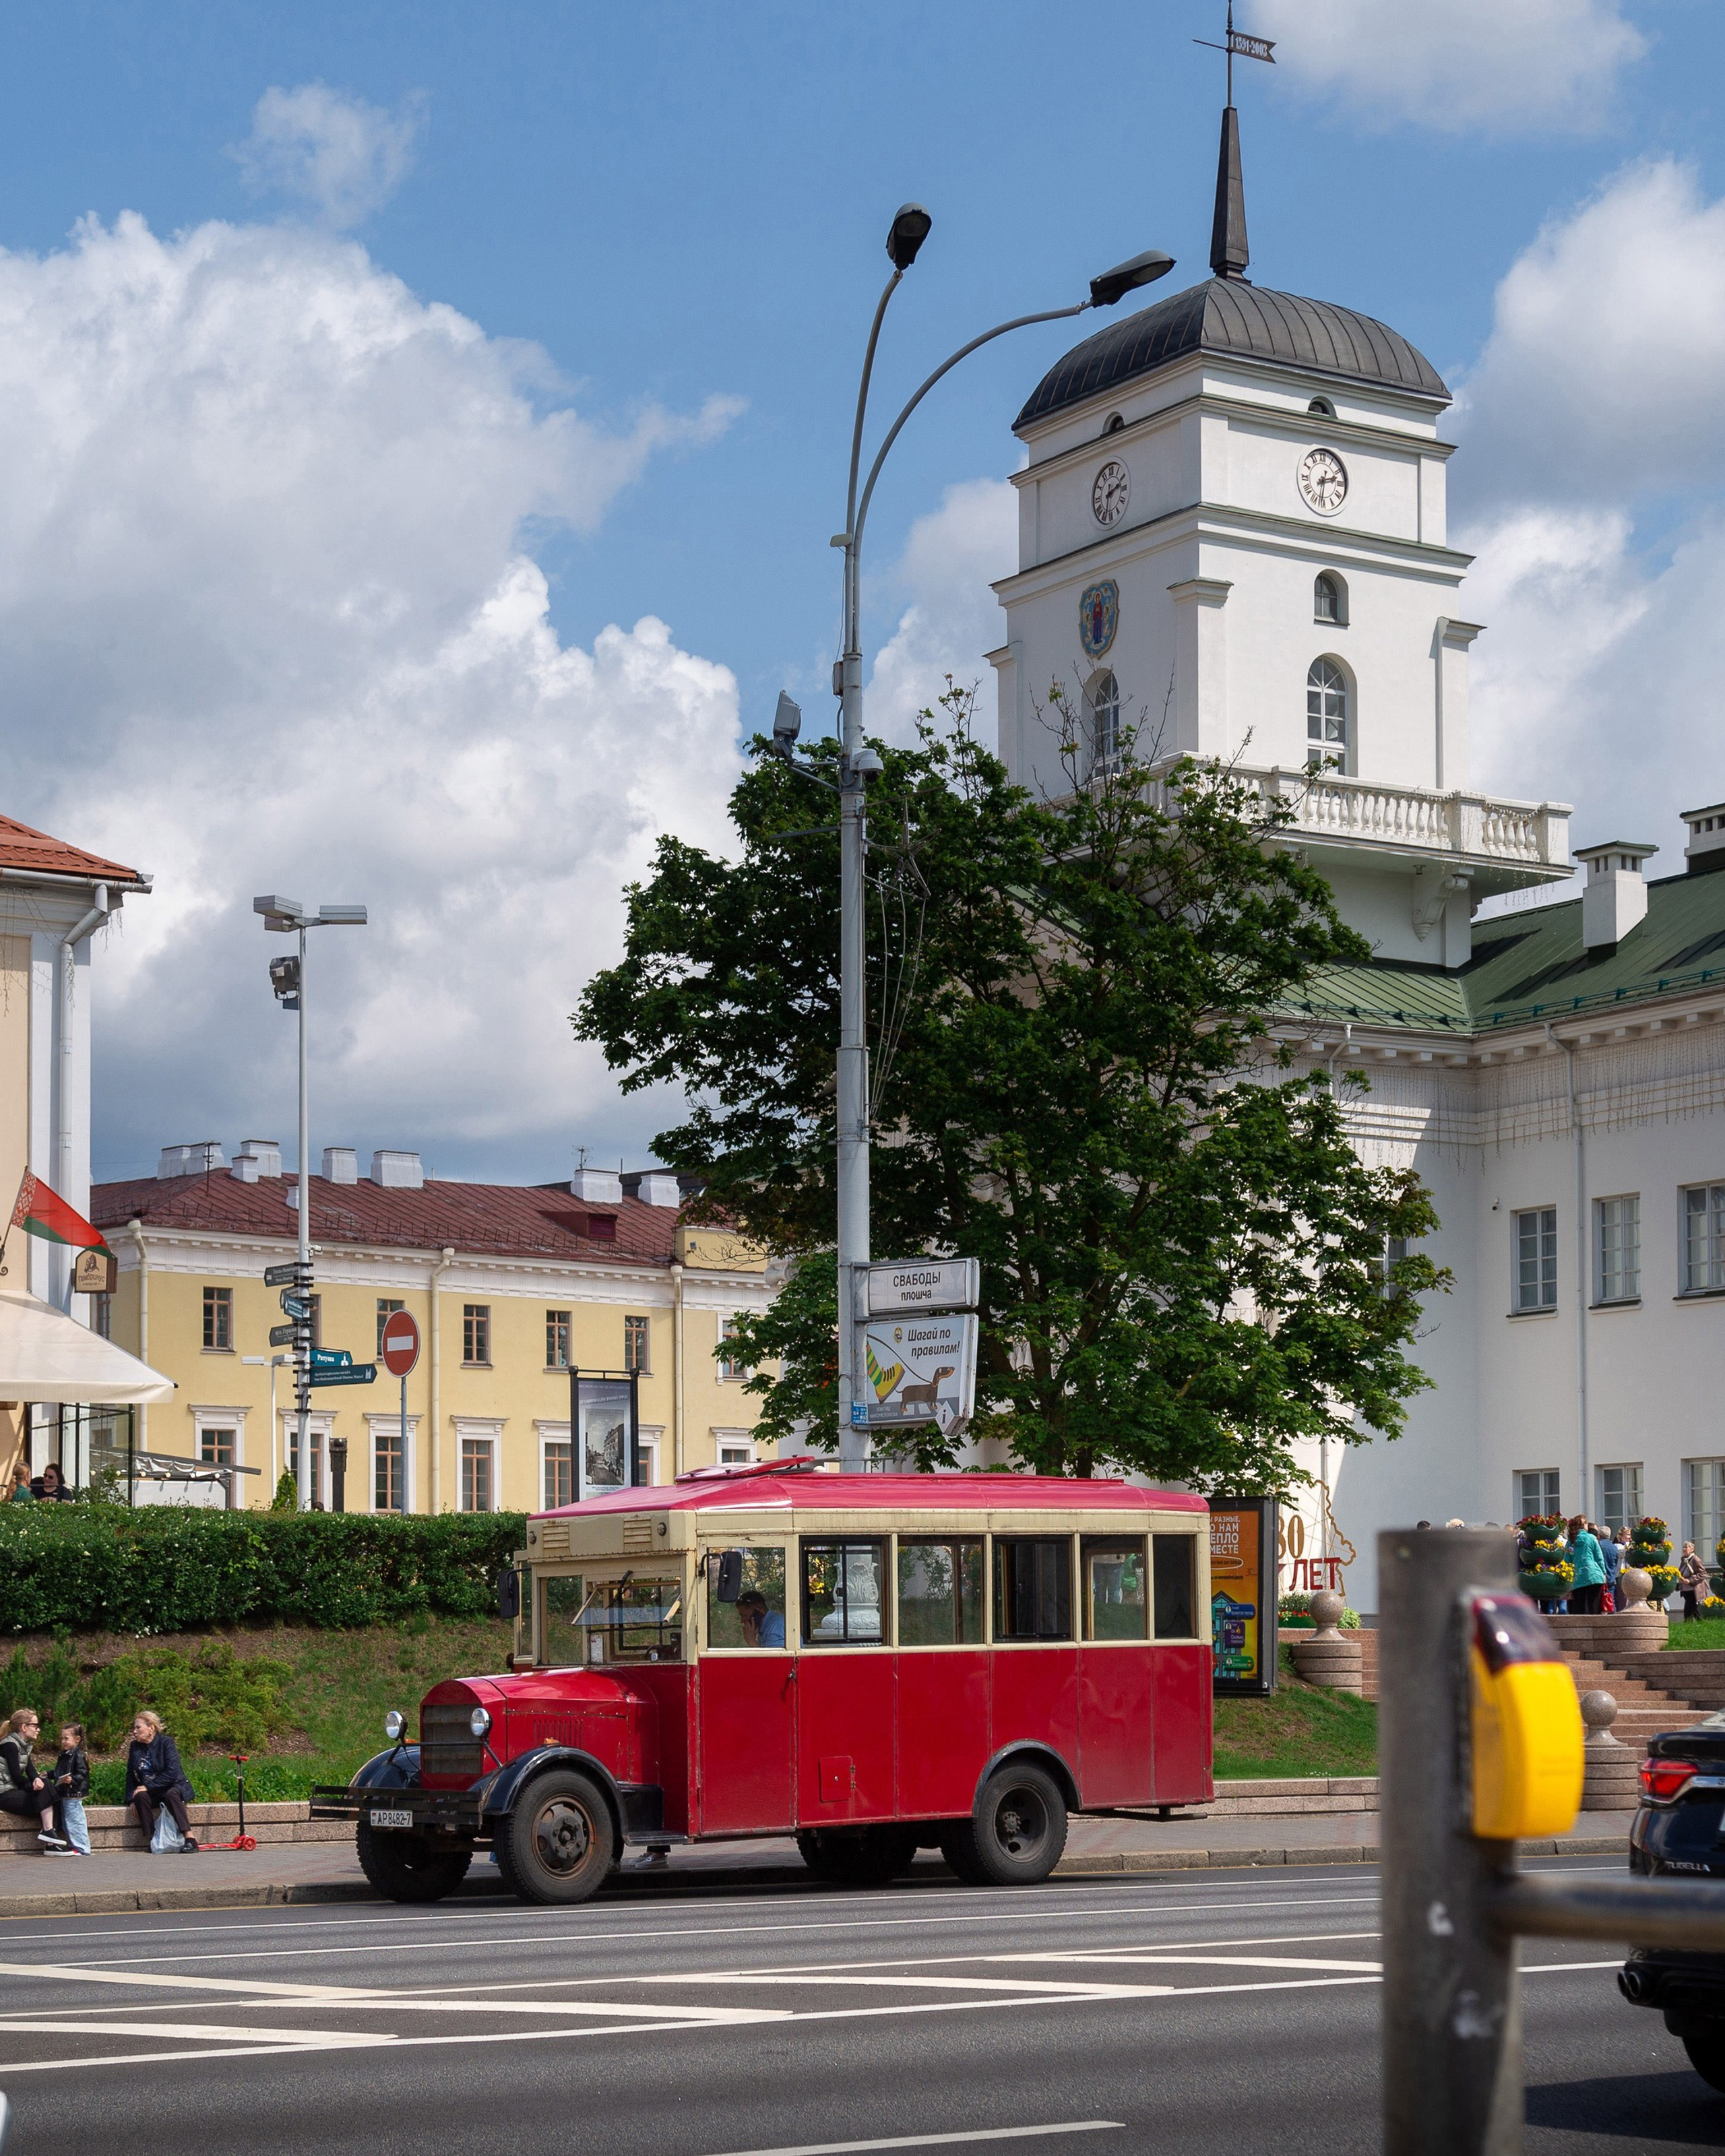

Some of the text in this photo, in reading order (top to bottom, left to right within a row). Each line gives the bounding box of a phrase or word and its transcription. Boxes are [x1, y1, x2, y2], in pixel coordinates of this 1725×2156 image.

[893, 1271, 941, 1288] СВАБОДЫ
[901, 1290, 932, 1302] плошча
[908, 1327, 951, 1342] Шагай по
[911, 1341, 960, 1360] правилам!
[1219, 1523, 1238, 1532] НАМ
[1210, 1533, 1239, 1544] ЕПЛО
[1210, 1544, 1238, 1554] МЕСТЕ
[1289, 1557, 1340, 1591] ЛЕТ
[1665, 1861, 1710, 1872] TUGELLA
